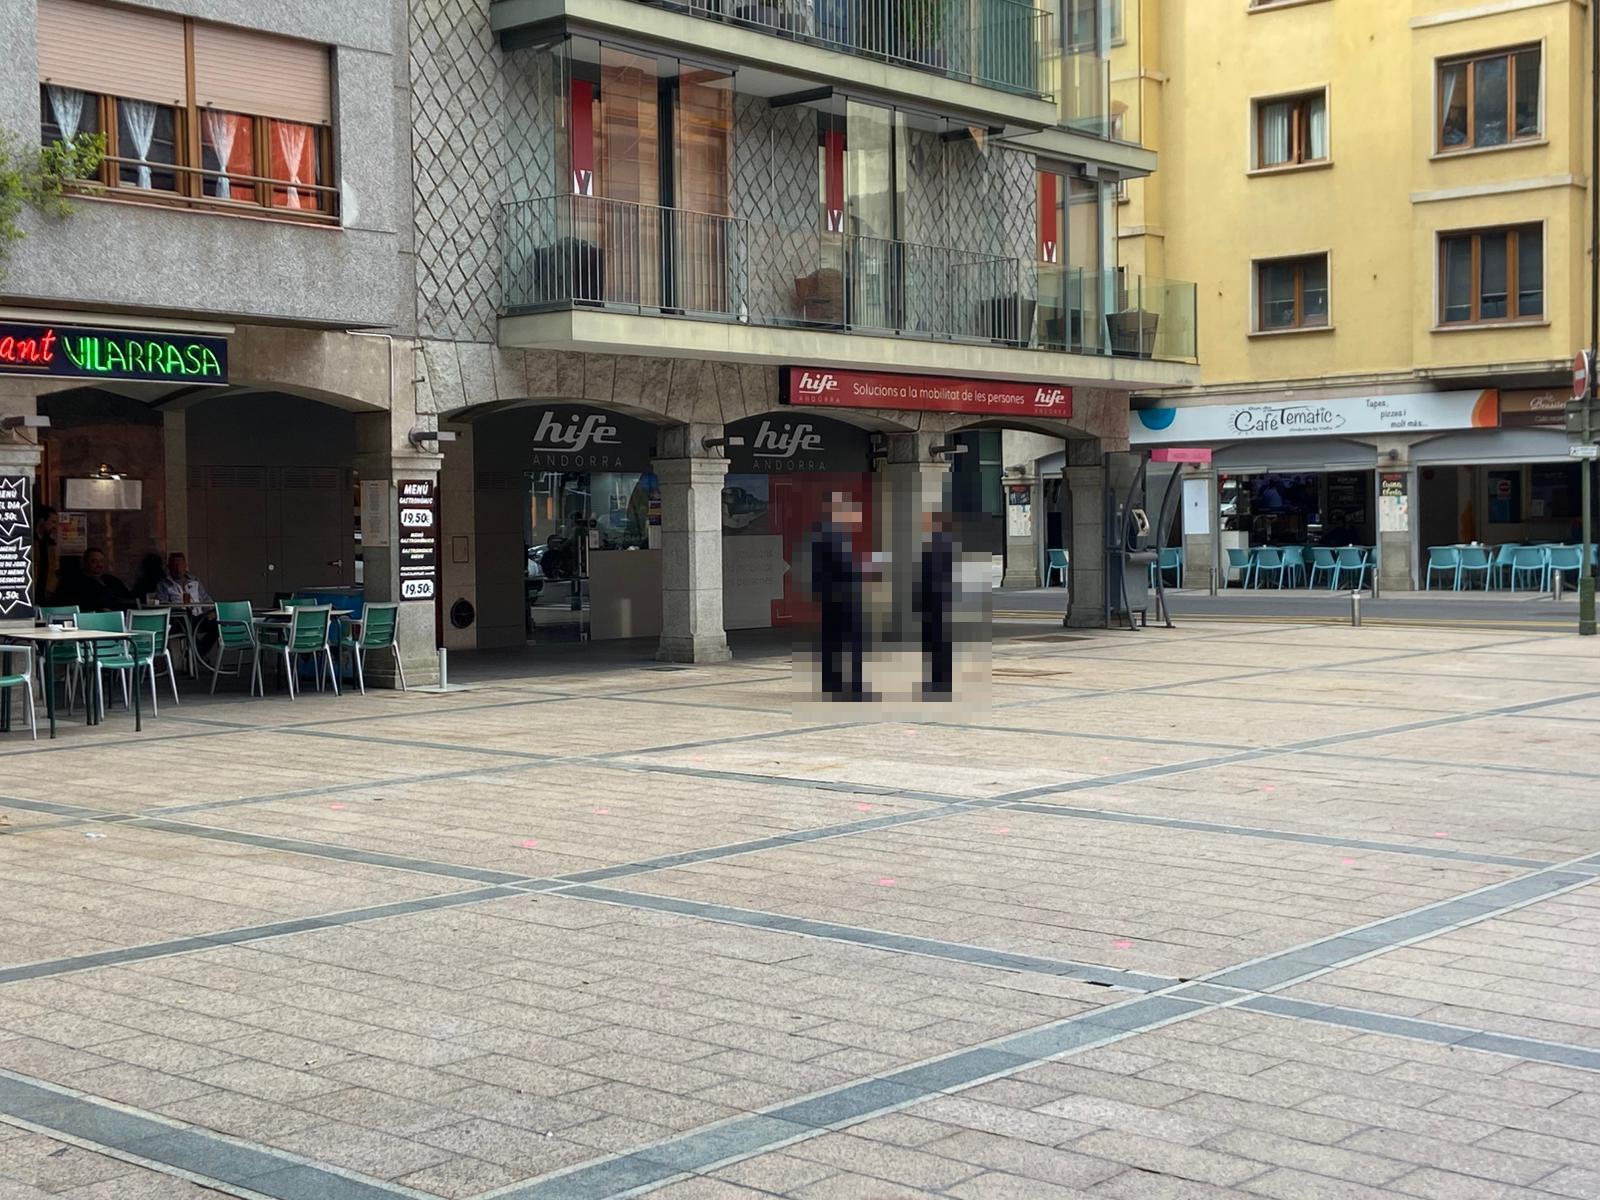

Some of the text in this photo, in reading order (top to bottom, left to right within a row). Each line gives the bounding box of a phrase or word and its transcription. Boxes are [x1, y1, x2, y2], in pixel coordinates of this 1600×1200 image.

[62, 336, 221, 376] VILARRASA
[798, 372, 840, 394] hife
[853, 382, 1025, 405] Solucions a la mobilitat de les persones
[1034, 388, 1066, 407] hife
[532, 411, 622, 453] hife
[1234, 411, 1278, 432] Café
[753, 420, 825, 458] hife
[531, 454, 623, 467] ANDORRA
[752, 460, 827, 471] ANDORRA
